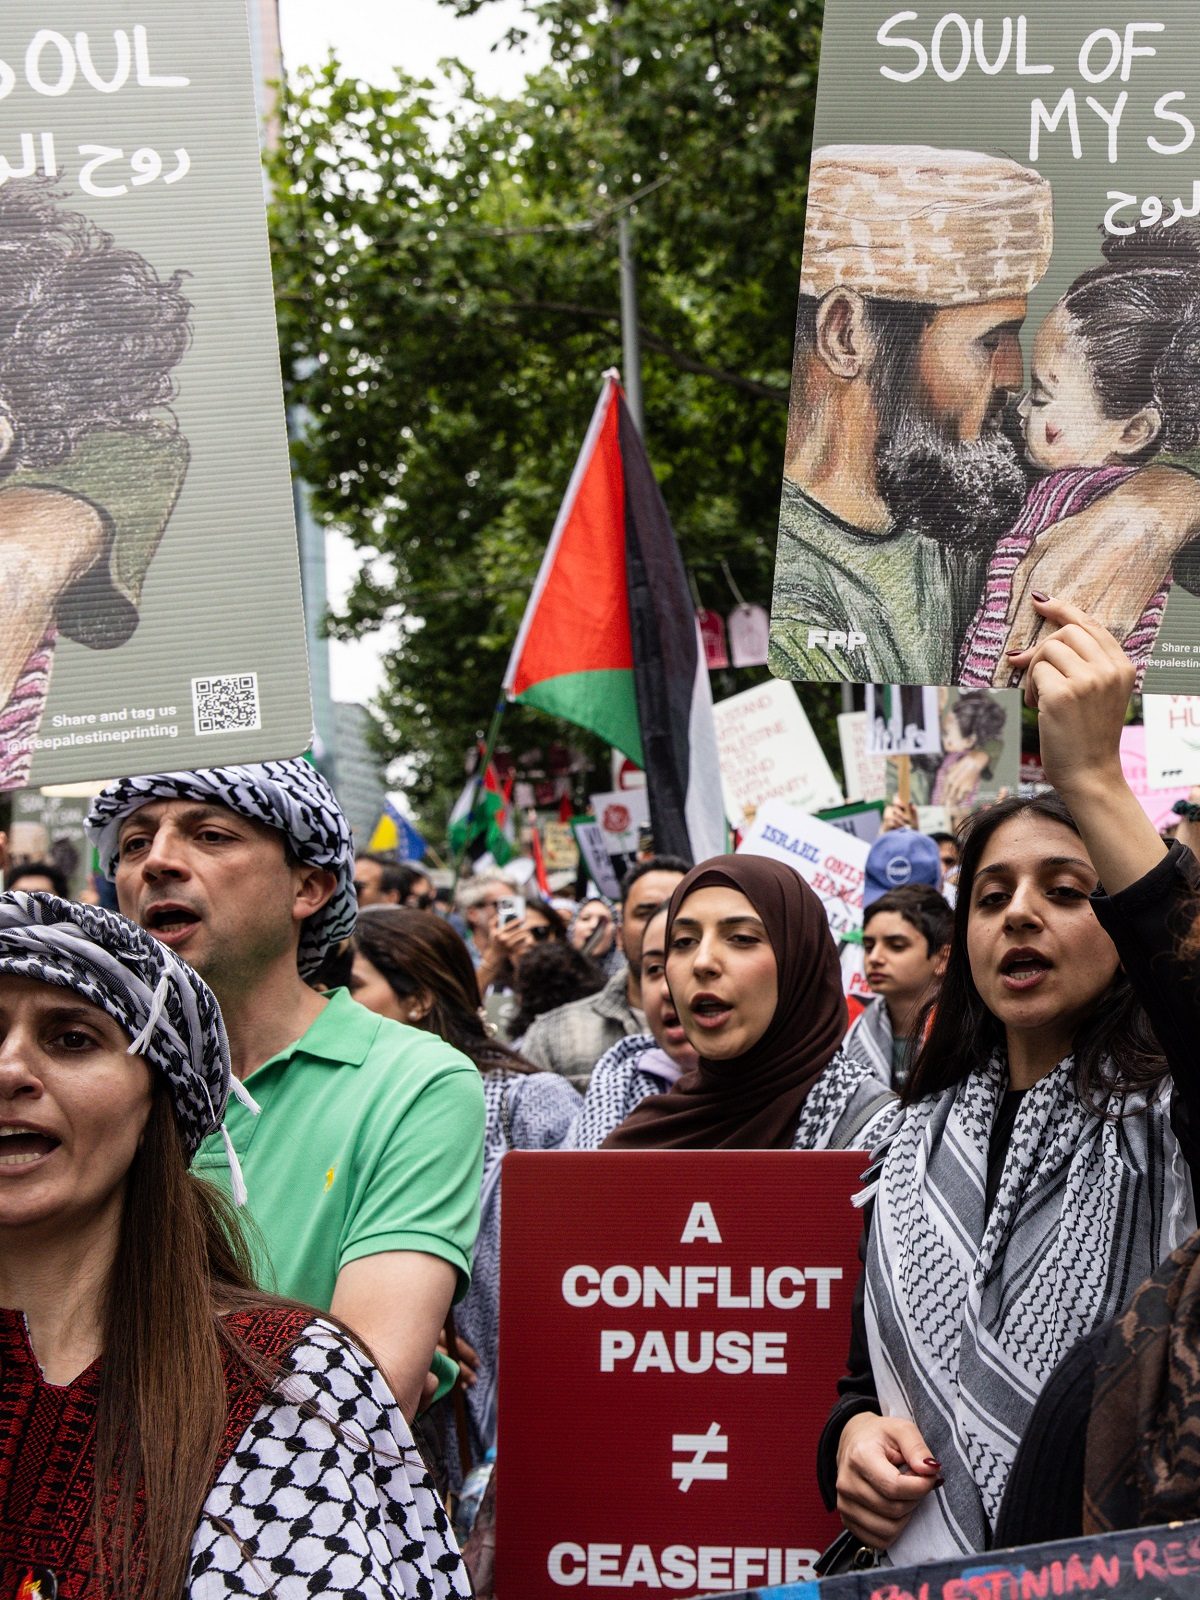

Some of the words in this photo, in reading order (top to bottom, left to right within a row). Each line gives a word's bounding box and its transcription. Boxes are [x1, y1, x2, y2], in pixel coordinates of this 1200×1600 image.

[877, 11, 1055, 82] SOUL
[1078, 23, 1165, 83] OF
[1028, 88, 1129, 163] MY
[78, 144, 191, 197] روح
[807, 630, 867, 651] FPP
[1161, 643, 1190, 653] Share
[52, 714, 96, 727] Share
[100, 708, 127, 722] and
[131, 707, 155, 720] tag
[158, 705, 177, 716] us
[7, 724, 178, 754] @freepalestineprinting
[761, 824, 821, 864] ISRAEL
[811, 872, 864, 909] HAMA
[679, 1202, 723, 1243] A
[561, 1265, 843, 1308] CONFLICT
[599, 1331, 788, 1374] PAUSE
[547, 1542, 822, 1590] CEASEFIR
